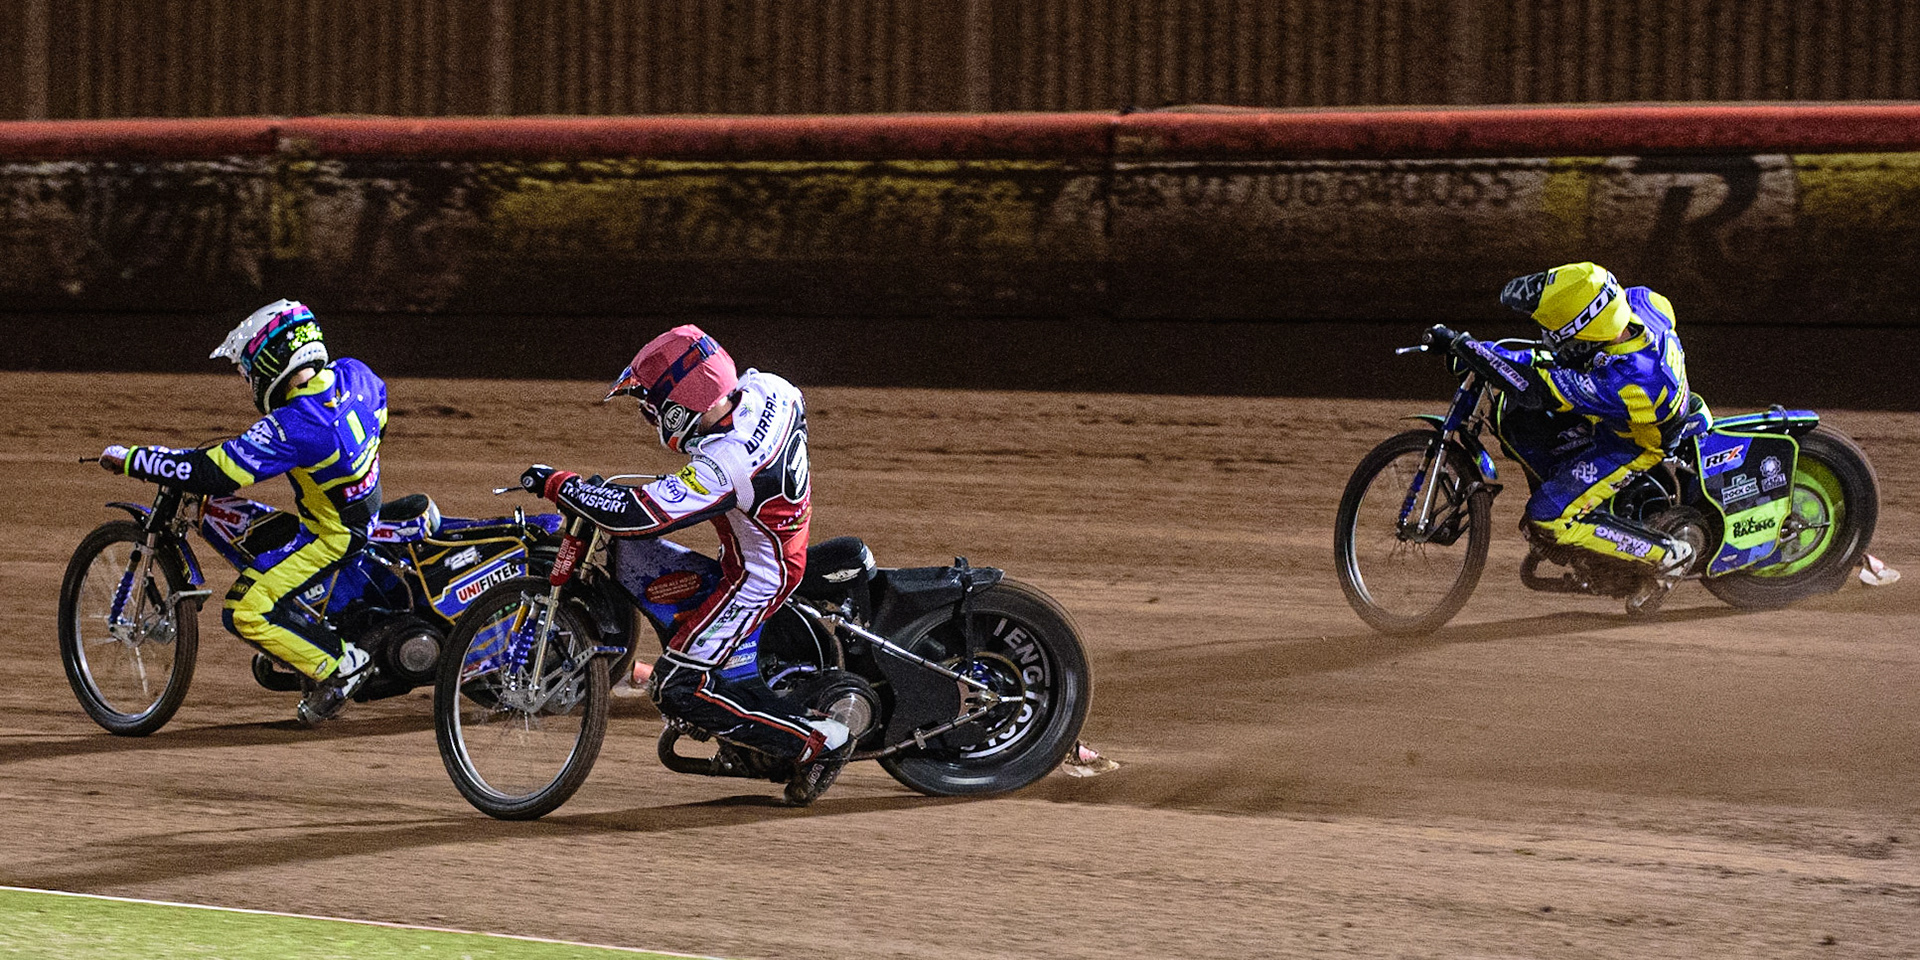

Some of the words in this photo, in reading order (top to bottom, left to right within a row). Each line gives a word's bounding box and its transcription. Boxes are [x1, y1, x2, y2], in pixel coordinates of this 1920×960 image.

[134, 449, 192, 480] Nice
[1705, 445, 1743, 468] RFX
[458, 565, 519, 601] UNIFILTER
